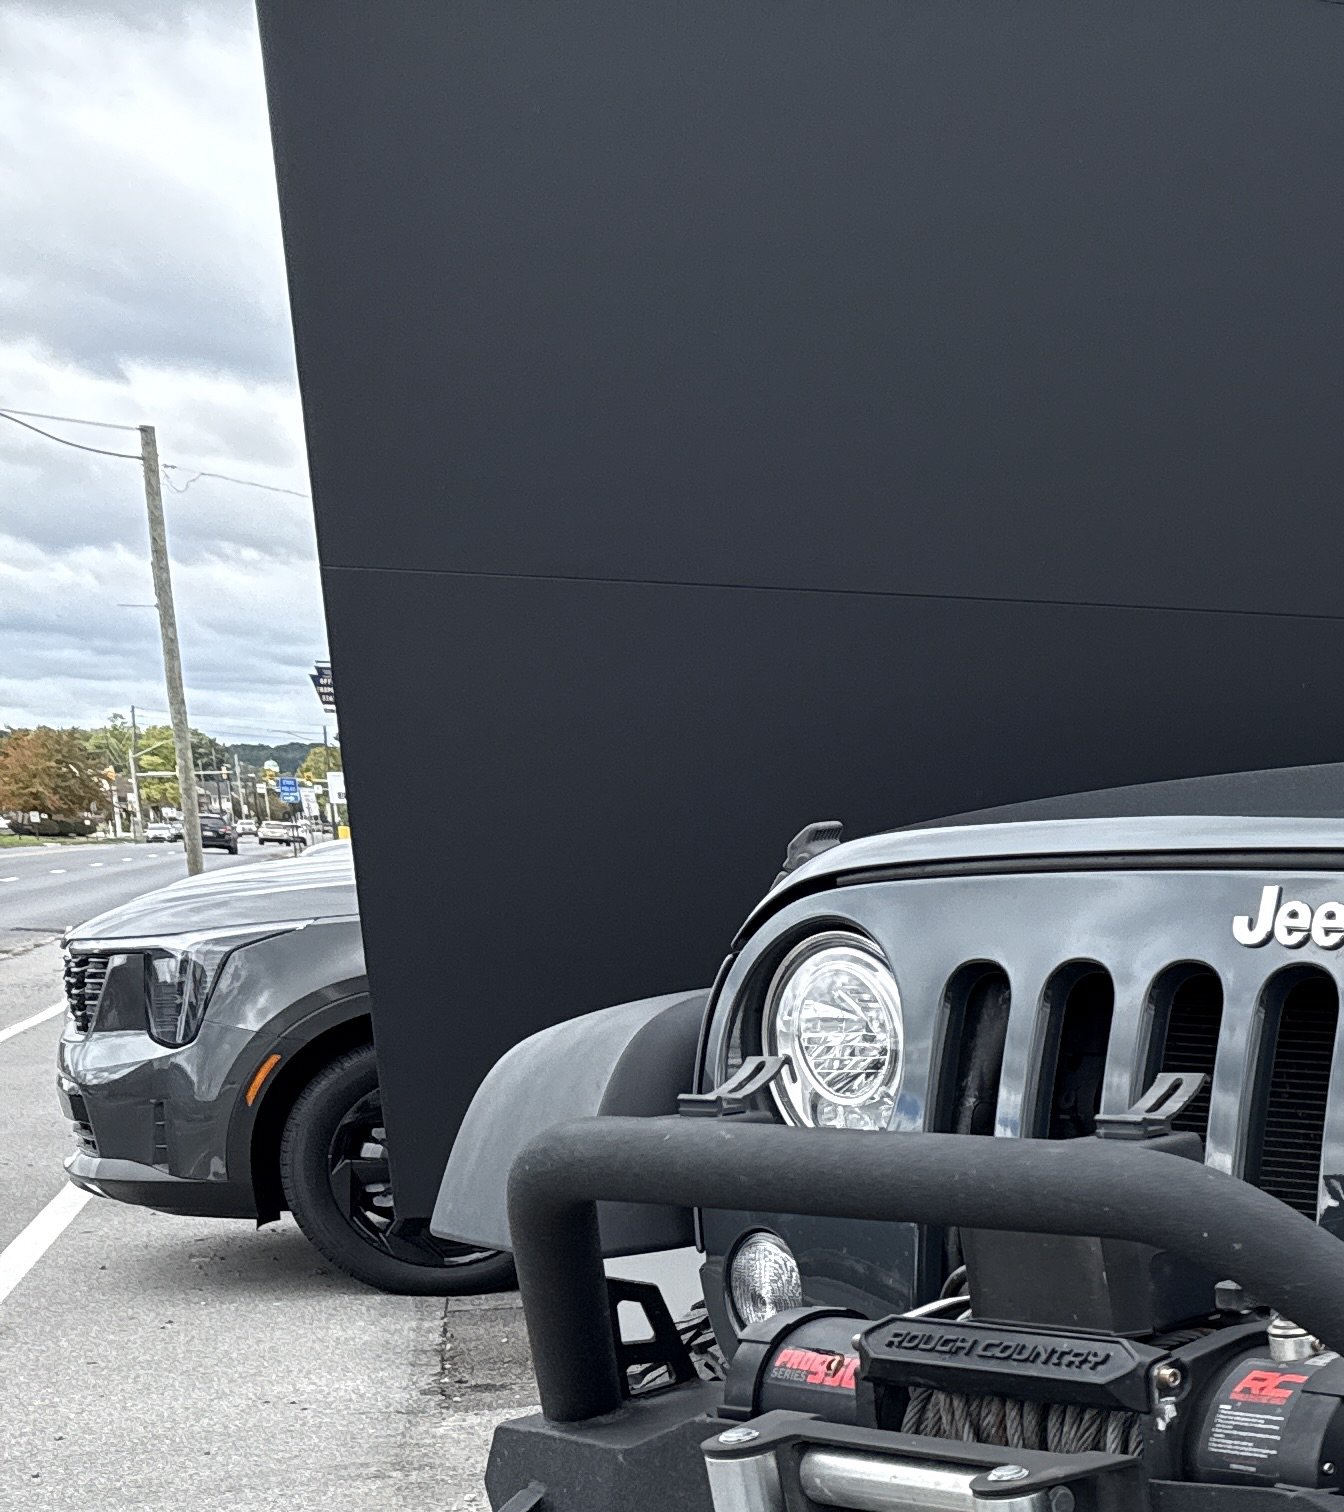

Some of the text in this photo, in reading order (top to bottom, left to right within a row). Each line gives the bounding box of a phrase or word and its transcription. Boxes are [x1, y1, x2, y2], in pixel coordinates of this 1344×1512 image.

[885, 1331, 1111, 1371] ROUGH COUNTRY
[771, 1367, 808, 1381] SERIES
